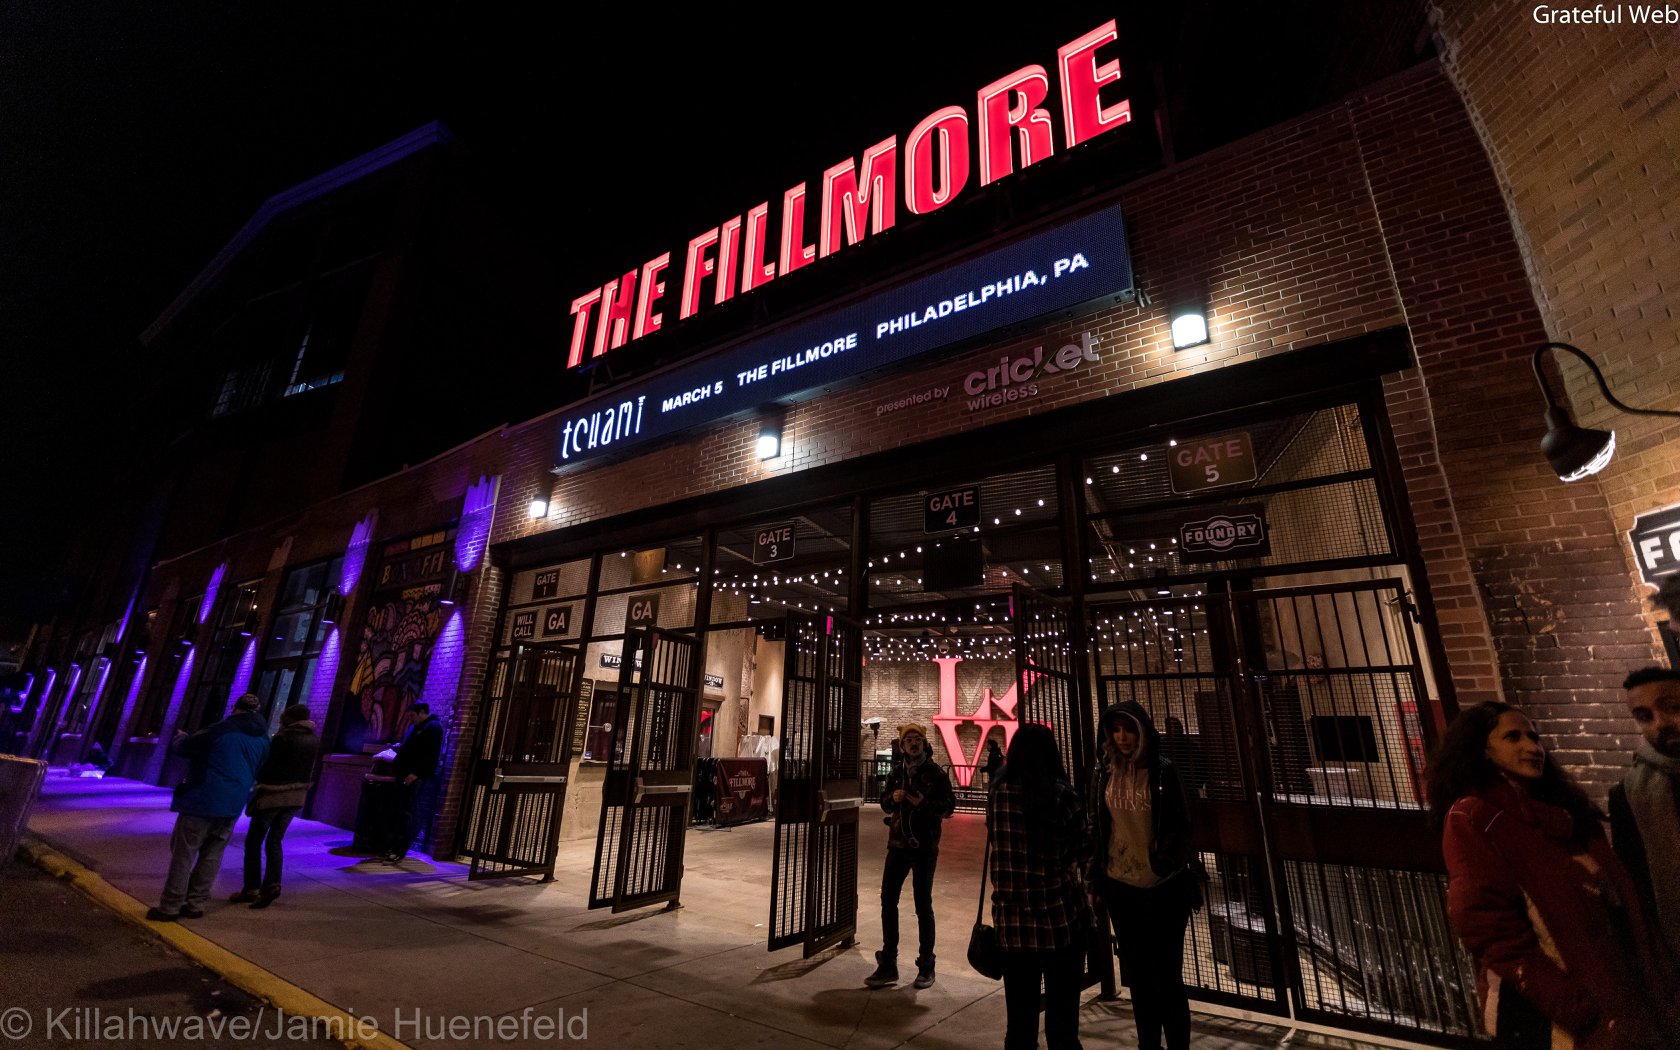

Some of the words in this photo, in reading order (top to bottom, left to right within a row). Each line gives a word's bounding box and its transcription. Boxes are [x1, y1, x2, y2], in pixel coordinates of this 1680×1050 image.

[567, 250, 670, 369] THE
[680, 19, 1131, 321] FILLMORE
[661, 384, 711, 413] MARCH
[713, 380, 724, 395] 5
[737, 364, 768, 386] THE
[771, 333, 858, 376] FILLMORE
[876, 269, 1048, 339] PHILADELPHIA,
[1053, 252, 1090, 278] PA
[963, 331, 1101, 396] cricket
[876, 389, 932, 417] presented
[933, 386, 950, 403] by
[966, 383, 1039, 412] wireless
[1176, 439, 1244, 467] GATE
[1204, 464, 1220, 482] 5
[929, 490, 975, 512] GATE
[945, 510, 958, 526] 4
[758, 527, 792, 546] GATE
[1184, 523, 1258, 543] FOUNDRY
[769, 544, 778, 558] 3
[536, 572, 557, 586] GATE
[542, 585, 547, 596] 1
[516, 613, 534, 627] WILL
[631, 600, 653, 621] GA
[547, 611, 566, 631] GA
[513, 625, 533, 638] CALL
[729, 776, 757, 791] FILLMORE
